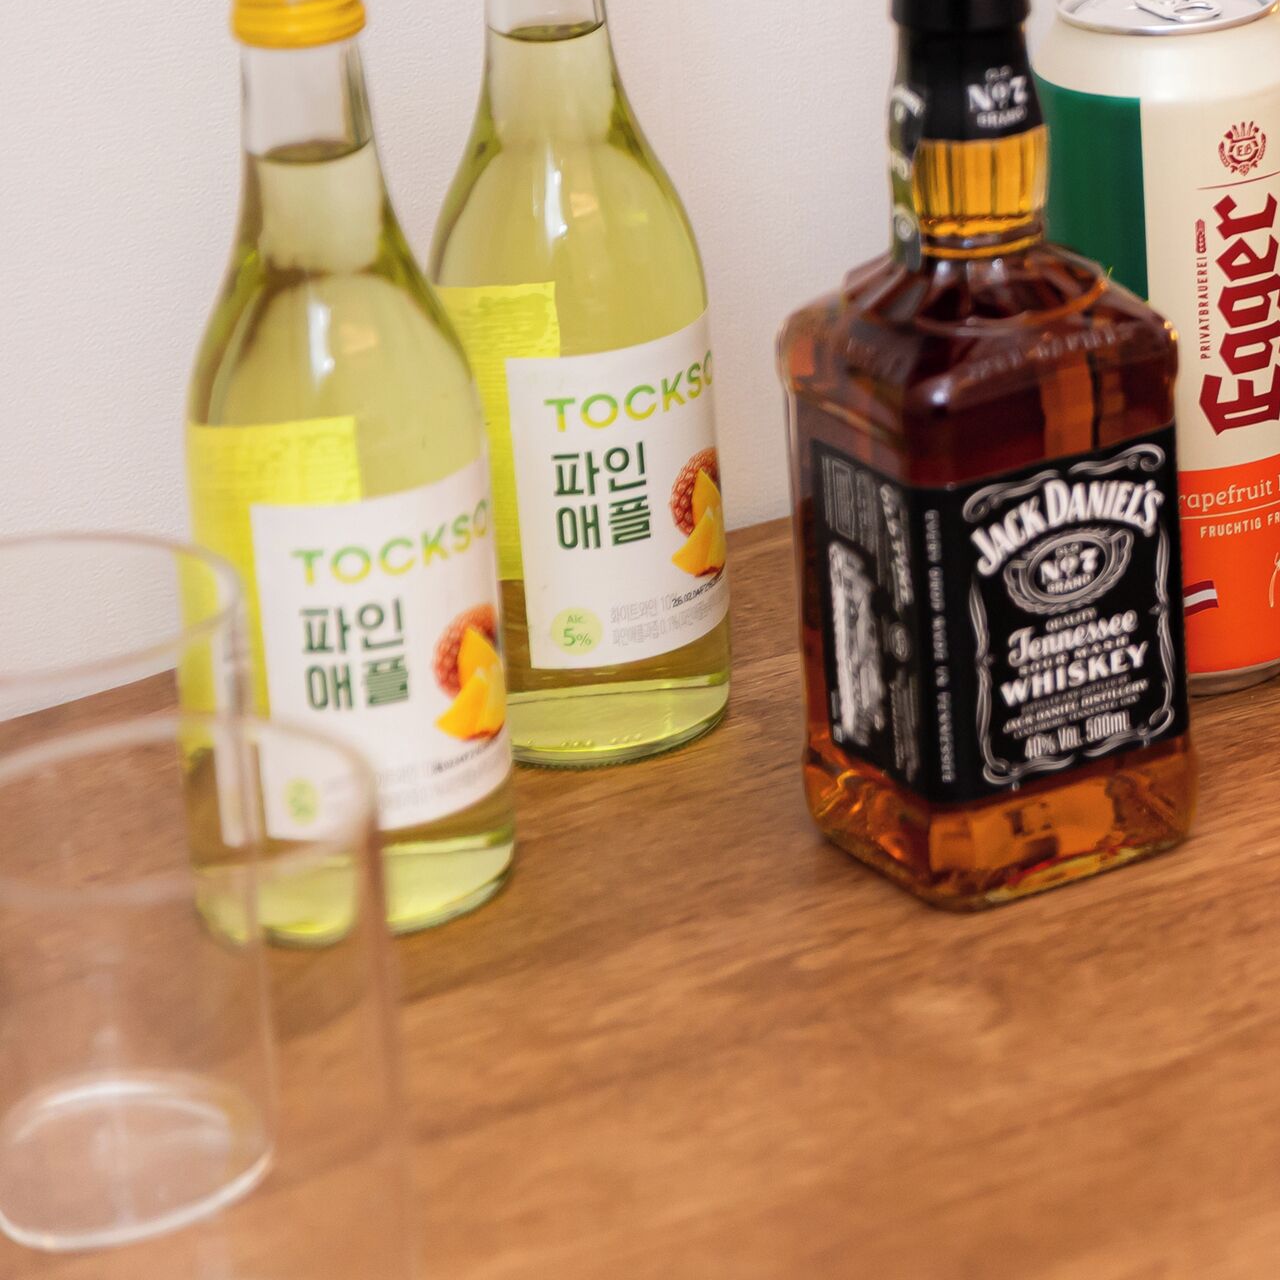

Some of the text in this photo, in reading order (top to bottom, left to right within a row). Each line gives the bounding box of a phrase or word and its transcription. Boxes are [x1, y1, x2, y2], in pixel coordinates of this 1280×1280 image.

[1196, 256, 1211, 359] PRIVATBRAUEREI
[550, 440, 648, 497] 파인
[1177, 480, 1273, 513] rapefruit
[554, 494, 652, 550] 애플
[970, 495, 1049, 577] JACK
[1200, 517, 1262, 538] FRUCHTIG
[299, 597, 405, 655] 파인
[562, 627, 592, 647] 5%
[1007, 609, 1138, 667] Tennessee
[1000, 640, 1149, 707] WHISKEY
